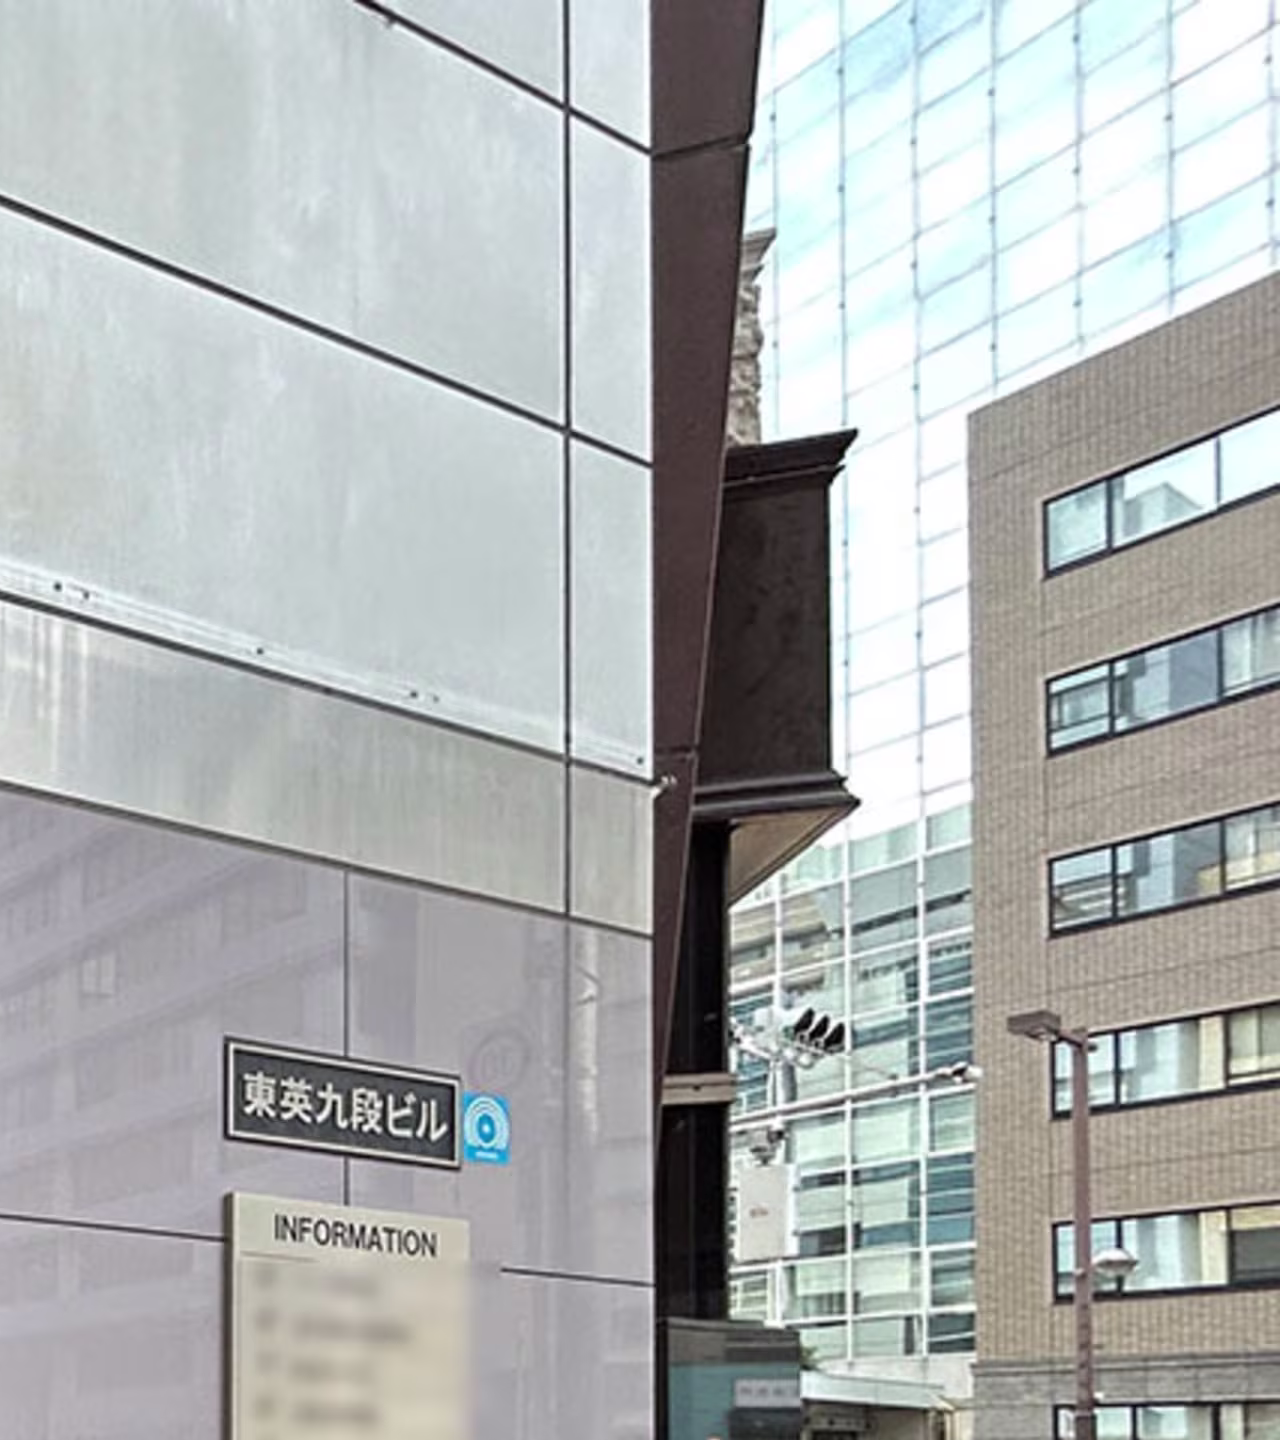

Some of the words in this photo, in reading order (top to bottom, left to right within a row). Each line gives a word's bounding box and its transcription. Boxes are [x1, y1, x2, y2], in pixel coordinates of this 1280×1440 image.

[243, 1071, 448, 1142] 東英九段ビル
[274, 1213, 437, 1257] INFORMATION
